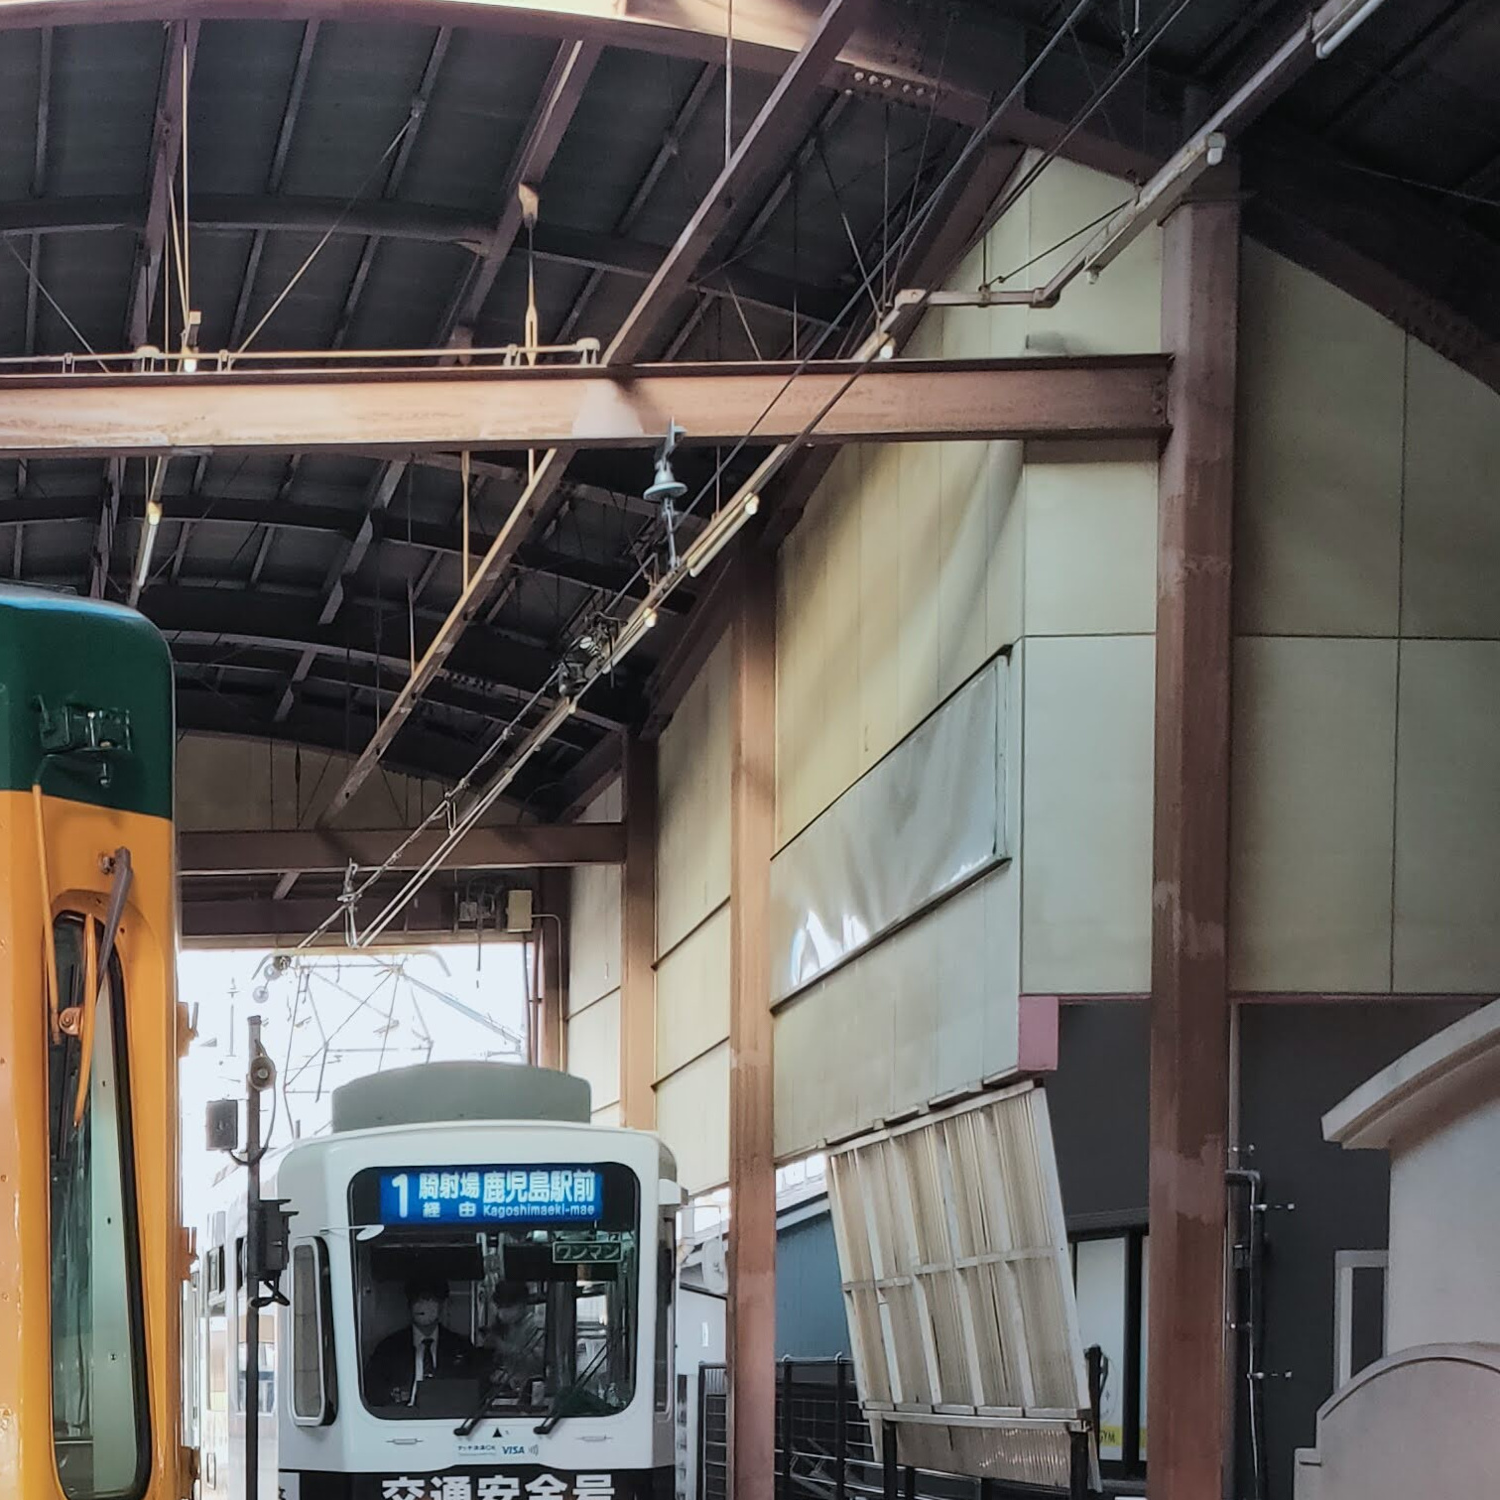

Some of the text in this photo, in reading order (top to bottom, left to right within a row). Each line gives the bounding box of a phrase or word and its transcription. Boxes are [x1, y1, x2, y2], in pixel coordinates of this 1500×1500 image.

[392, 1169, 596, 1218] 1 騎射場 鹿児島駅前
[483, 1203, 595, 1218] Kagoshimaeki-mae
[556, 1244, 621, 1259] ワンマン
[502, 1446, 525, 1455] VISA
